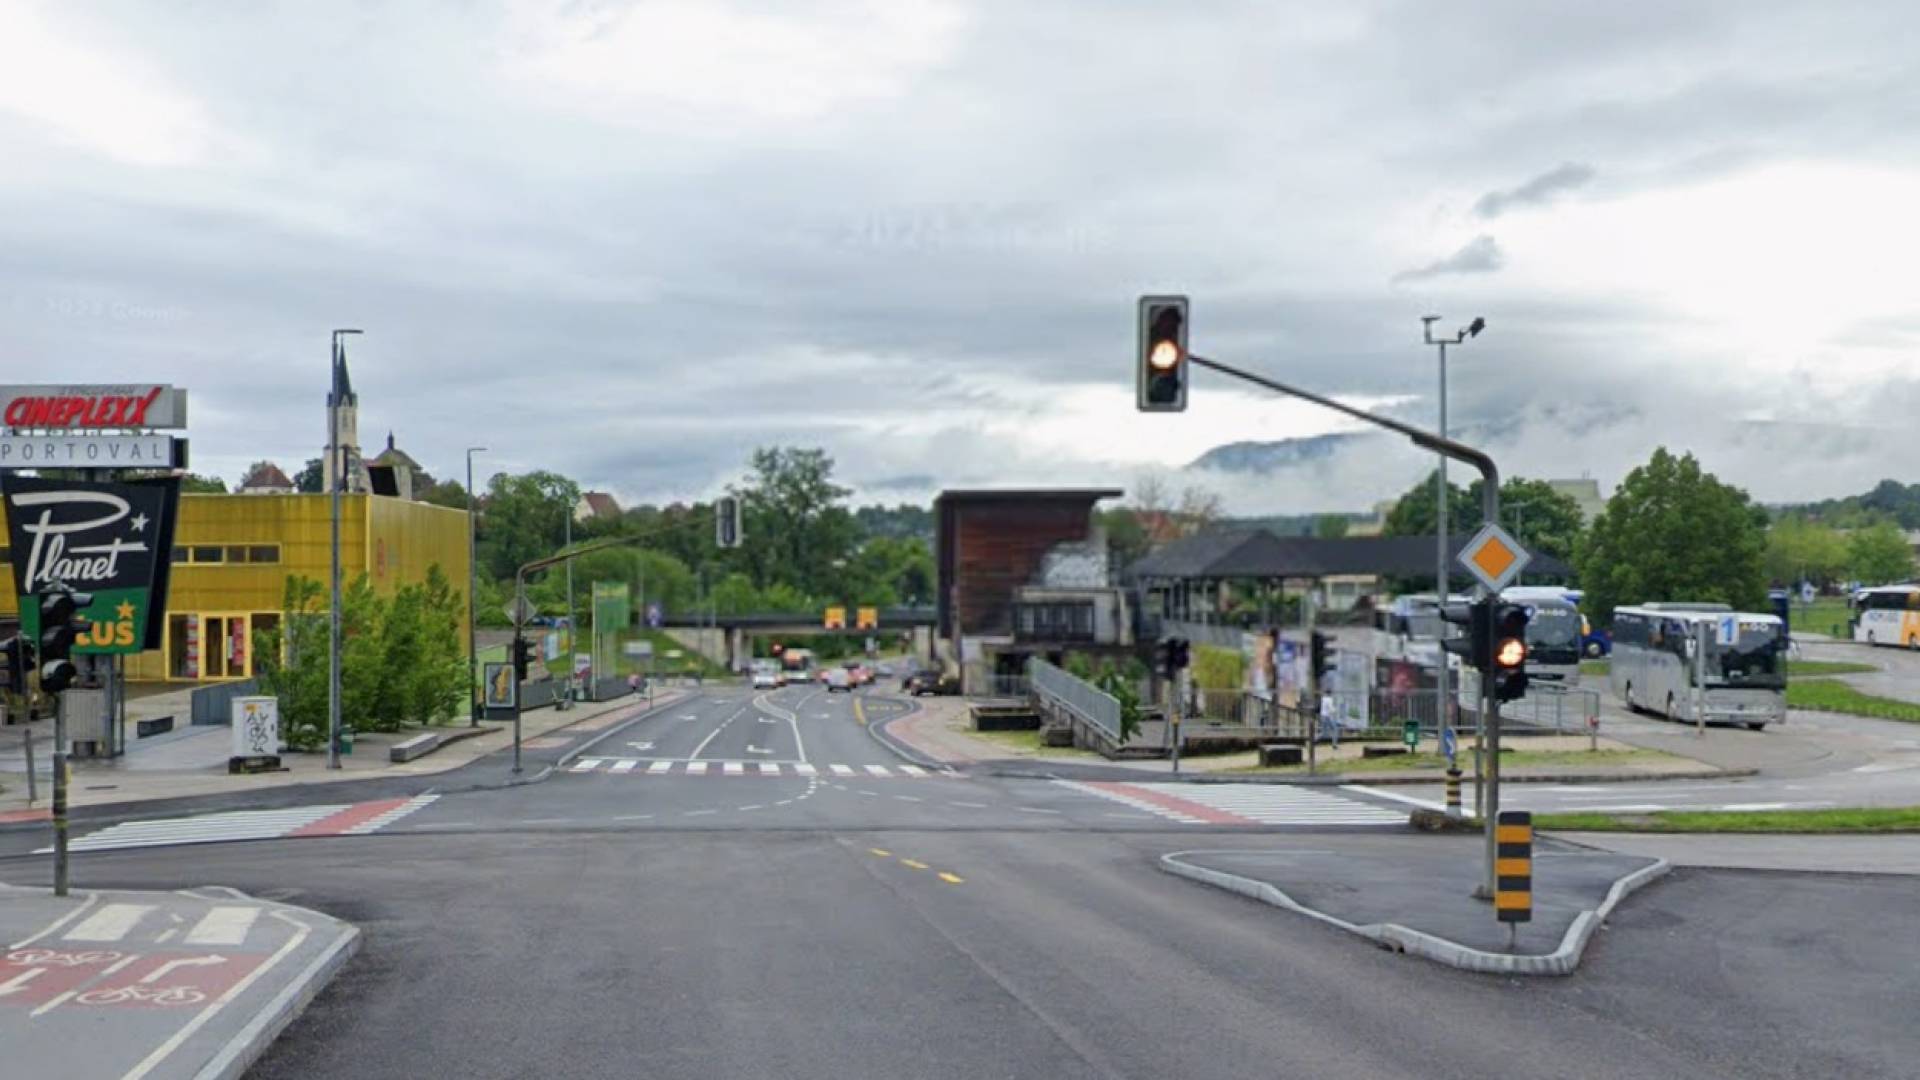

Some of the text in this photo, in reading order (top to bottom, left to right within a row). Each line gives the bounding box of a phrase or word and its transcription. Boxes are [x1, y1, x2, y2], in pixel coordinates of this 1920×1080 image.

[5, 386, 162, 427] CINEPLEXX
[1, 443, 162, 461] PORTOVAL
[11, 490, 148, 593] Planet
[1722, 618, 1734, 642] 1
